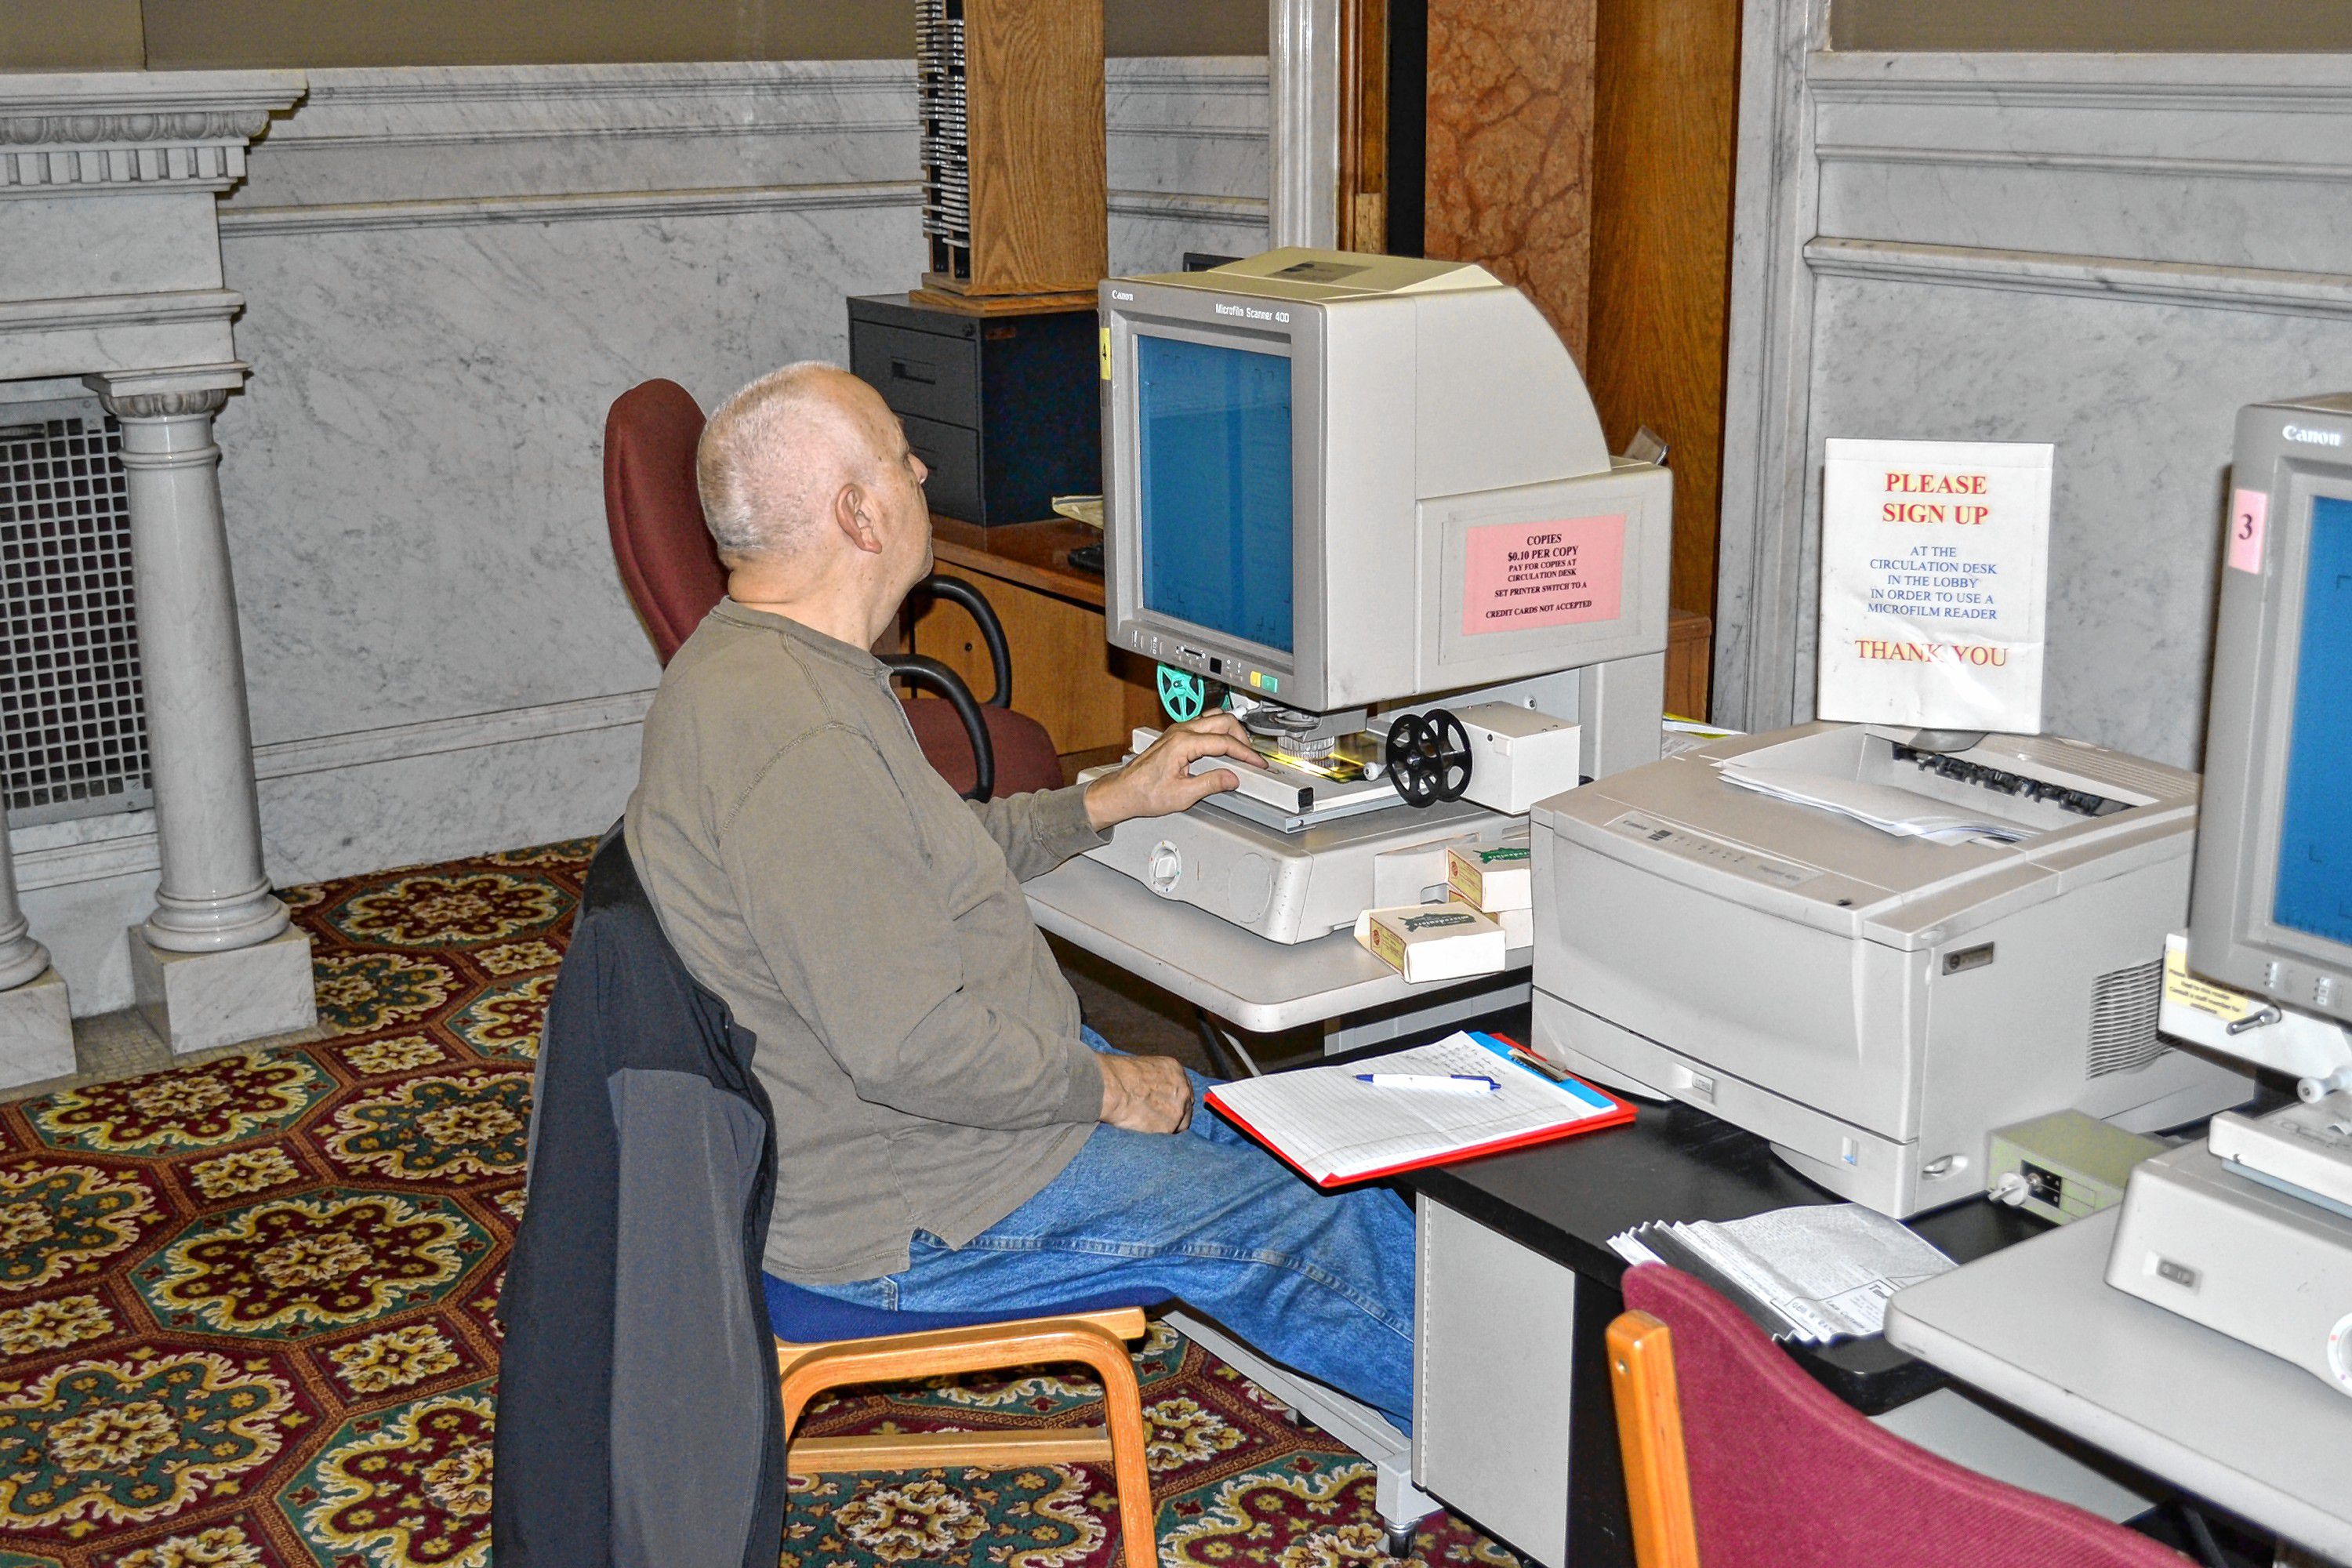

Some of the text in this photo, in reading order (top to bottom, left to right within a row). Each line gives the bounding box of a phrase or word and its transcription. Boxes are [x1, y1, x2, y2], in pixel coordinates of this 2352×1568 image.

[1112, 289, 1134, 302] Canon
[1215, 303, 1290, 324] Microfilm Scanner 400
[2282, 425, 2341, 446] Canon
[1885, 473, 1987, 495] PLEASE
[1882, 503, 1989, 525] SIGN UP
[2238, 514, 2252, 541] 3
[1526, 533, 1562, 546] COPIES
[1508, 545, 1579, 561] $0.10 PER COPY
[1910, 546, 1957, 557] AT THE
[1508, 558, 1577, 572] PAY FOR COPIES AT
[1870, 558, 1998, 575] CIRCULATION DESK
[1507, 568, 1577, 583] CIRCULATION DESK
[1887, 575, 1979, 589] IN THE LOBBY
[1509, 586, 1541, 596] PRINTER
[1541, 583, 1570, 593] SWITCH
[1871, 588, 1994, 604] IN ORDER TO USE A
[1486, 600, 1592, 619] CREDIT CARDS NOT ACCEPTED
[1867, 603, 1998, 619] MICROFILM READER
[1854, 639, 2009, 667] THANK YOU
